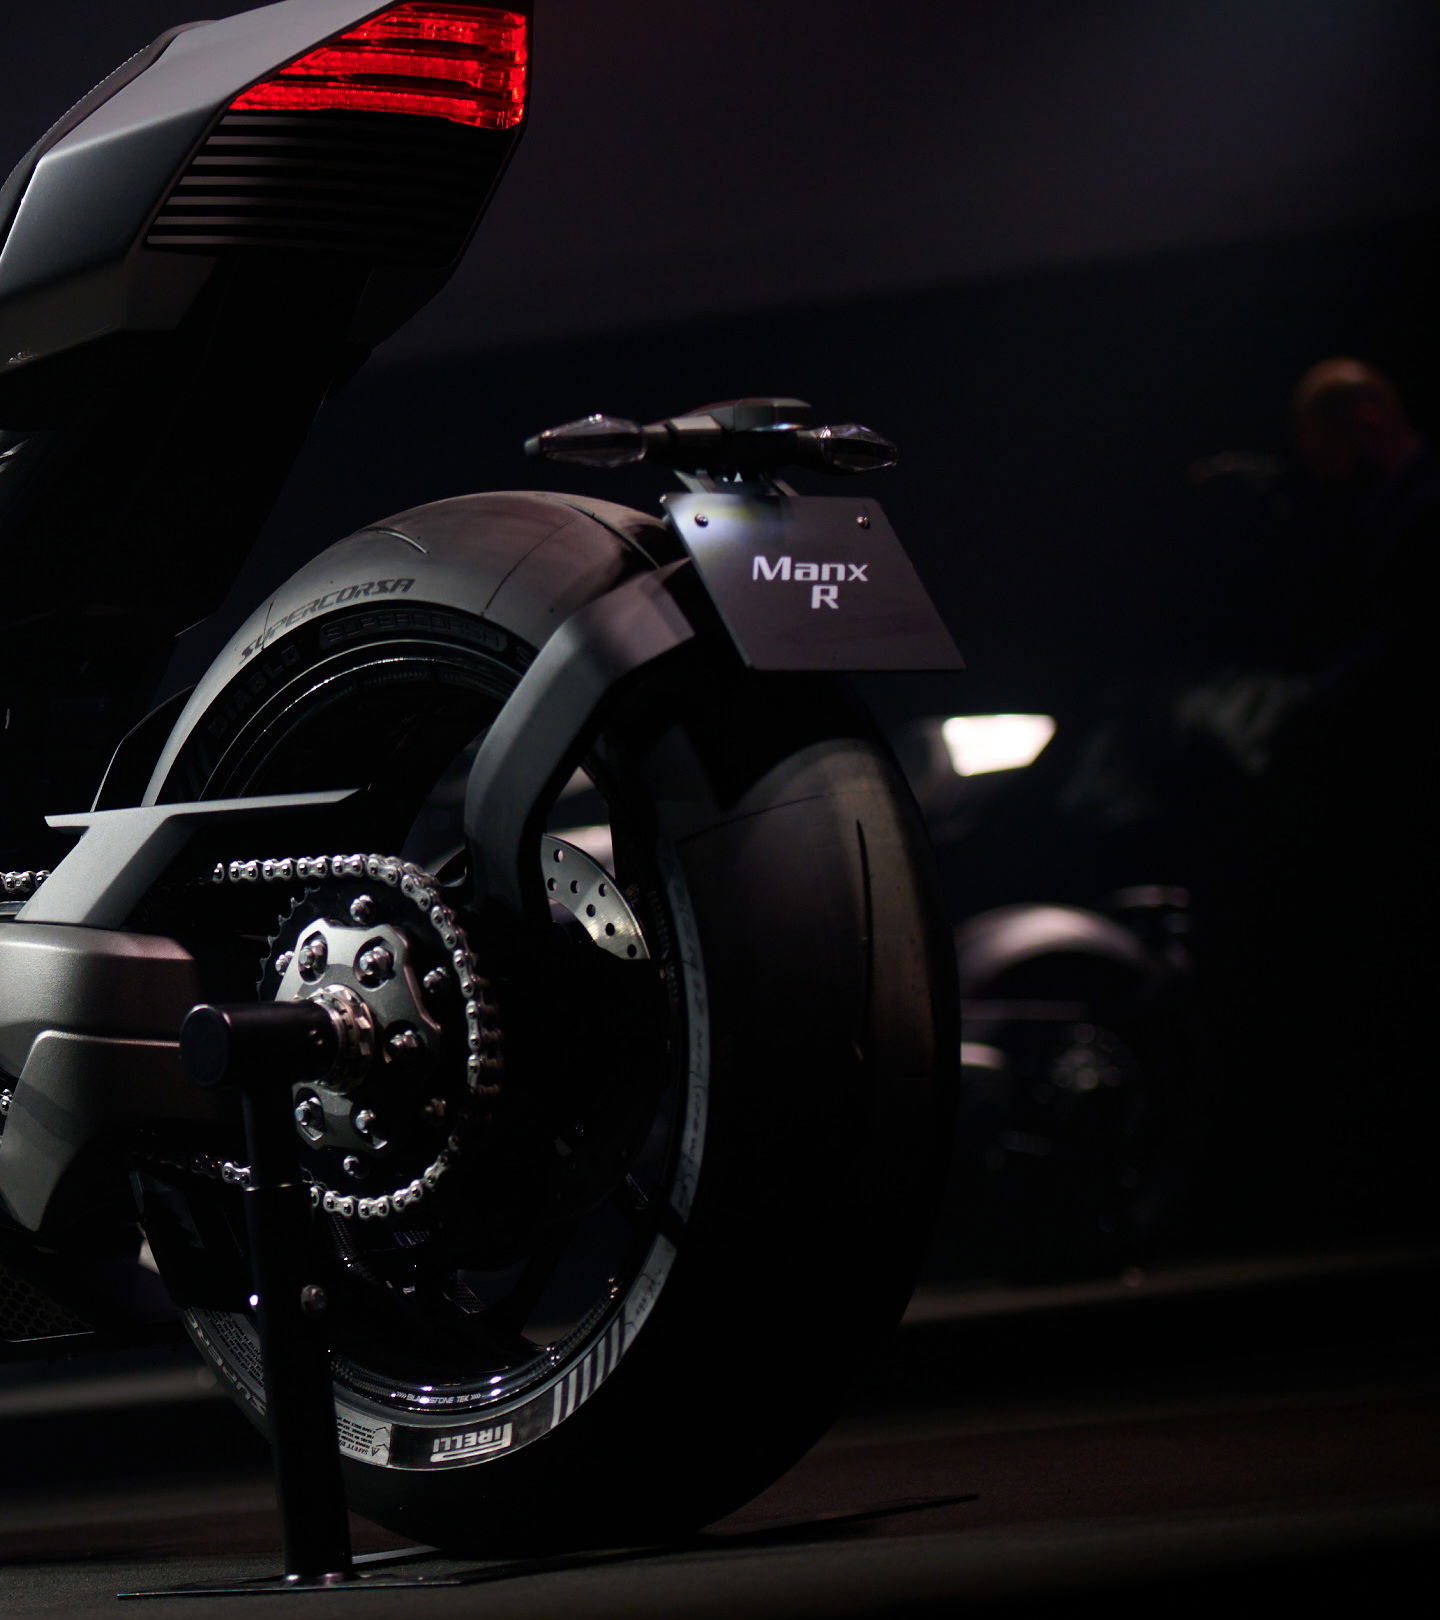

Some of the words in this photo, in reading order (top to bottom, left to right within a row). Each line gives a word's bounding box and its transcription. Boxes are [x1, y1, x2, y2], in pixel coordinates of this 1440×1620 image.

[752, 555, 869, 582] Manx
[811, 584, 839, 609] R
[239, 578, 417, 665] SUPERCORSA
[323, 611, 501, 650] SUPERCORSA
[406, 1393, 454, 1404] BLASTONE
[430, 1422, 513, 1463] PIRELLI
